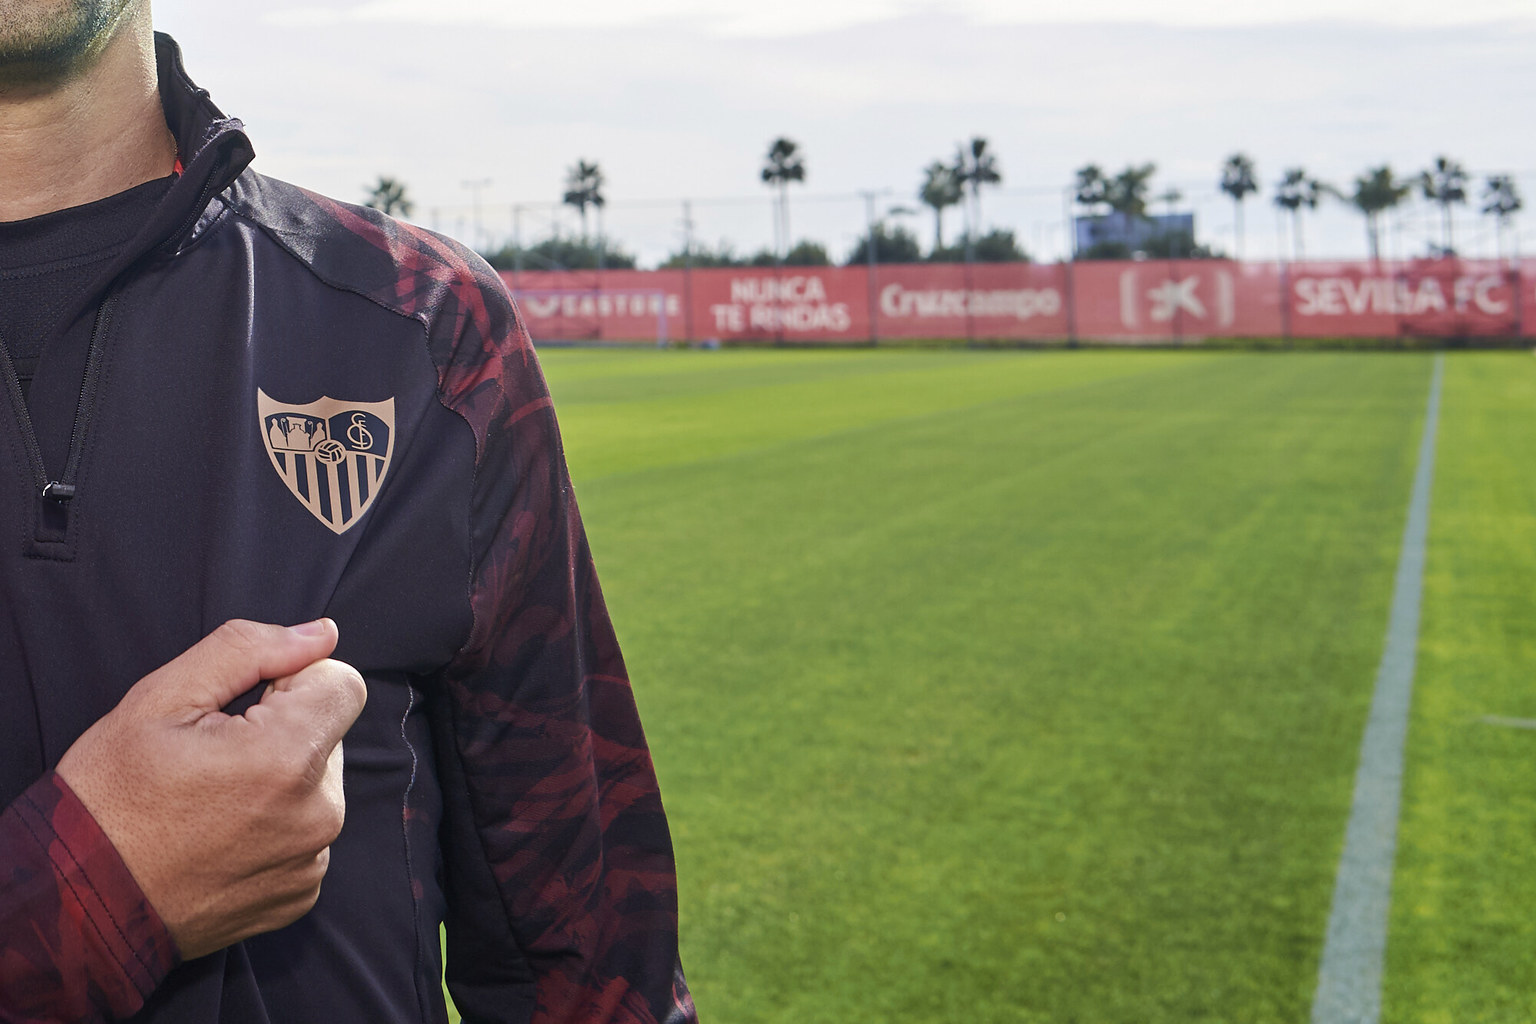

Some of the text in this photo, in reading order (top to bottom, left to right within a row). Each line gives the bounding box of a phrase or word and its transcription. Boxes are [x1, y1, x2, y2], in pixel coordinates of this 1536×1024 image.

[730, 275, 827, 304] NUNCA
[1295, 276, 1509, 316] SEVILLA FC
[710, 303, 745, 333] TE
